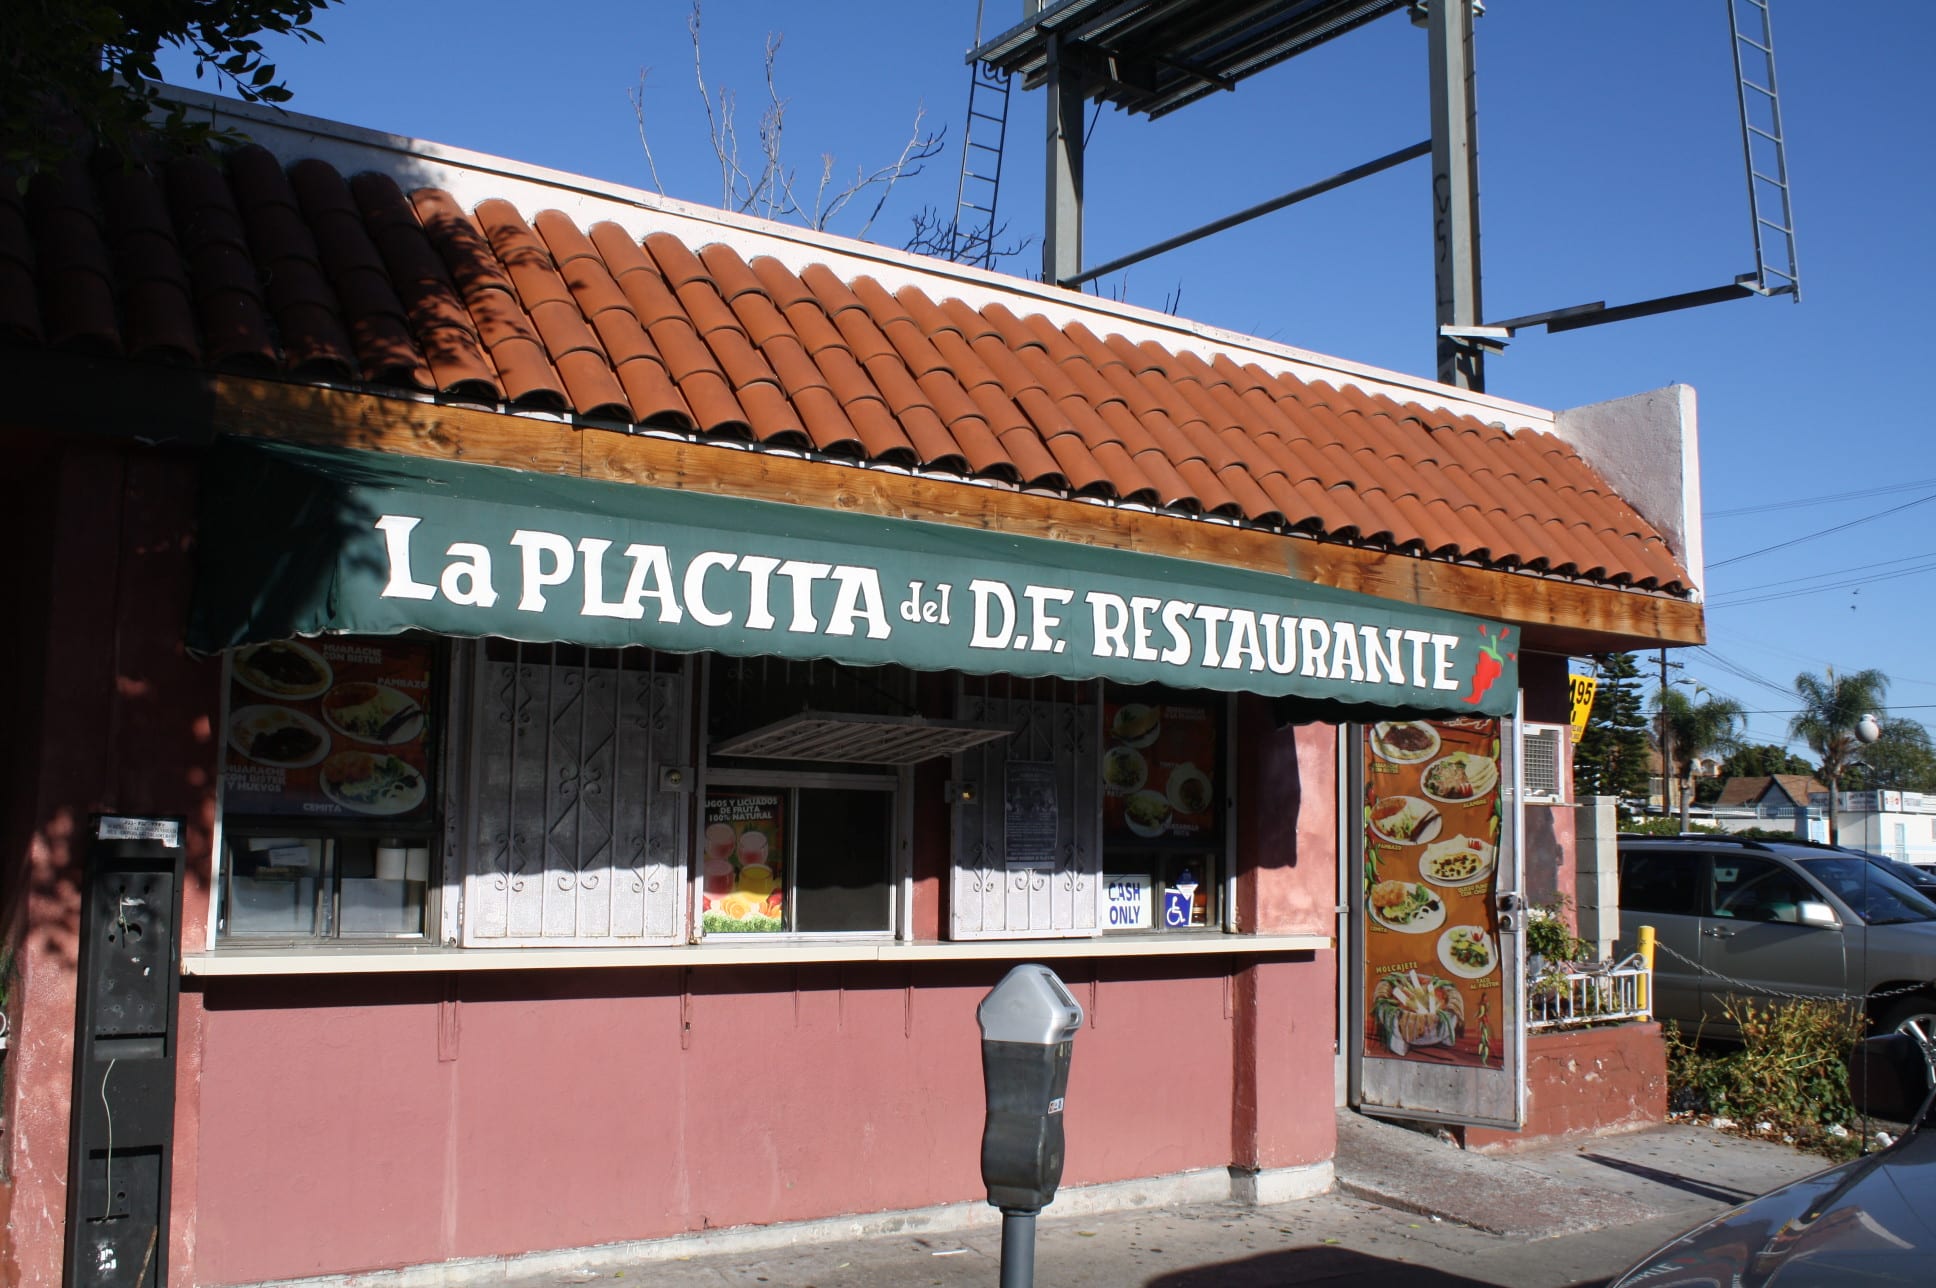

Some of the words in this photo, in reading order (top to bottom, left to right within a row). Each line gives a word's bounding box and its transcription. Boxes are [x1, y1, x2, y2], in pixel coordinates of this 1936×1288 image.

[375, 514, 500, 608] La
[510, 529, 893, 641] PLACITA
[899, 581, 952, 626] del
[1085, 592, 1461, 691] RESTAURANTE
[303, 803, 342, 813] CEMITA
[704, 799, 728, 808] UGOS
[737, 796, 778, 807] LICUADOS
[709, 814, 731, 822] 100%
[732, 812, 773, 821] NATURAL
[1109, 882, 1140, 902] CASH
[1109, 906, 1140, 925] ONLY
[1376, 961, 1418, 974] MOLCAJETE
